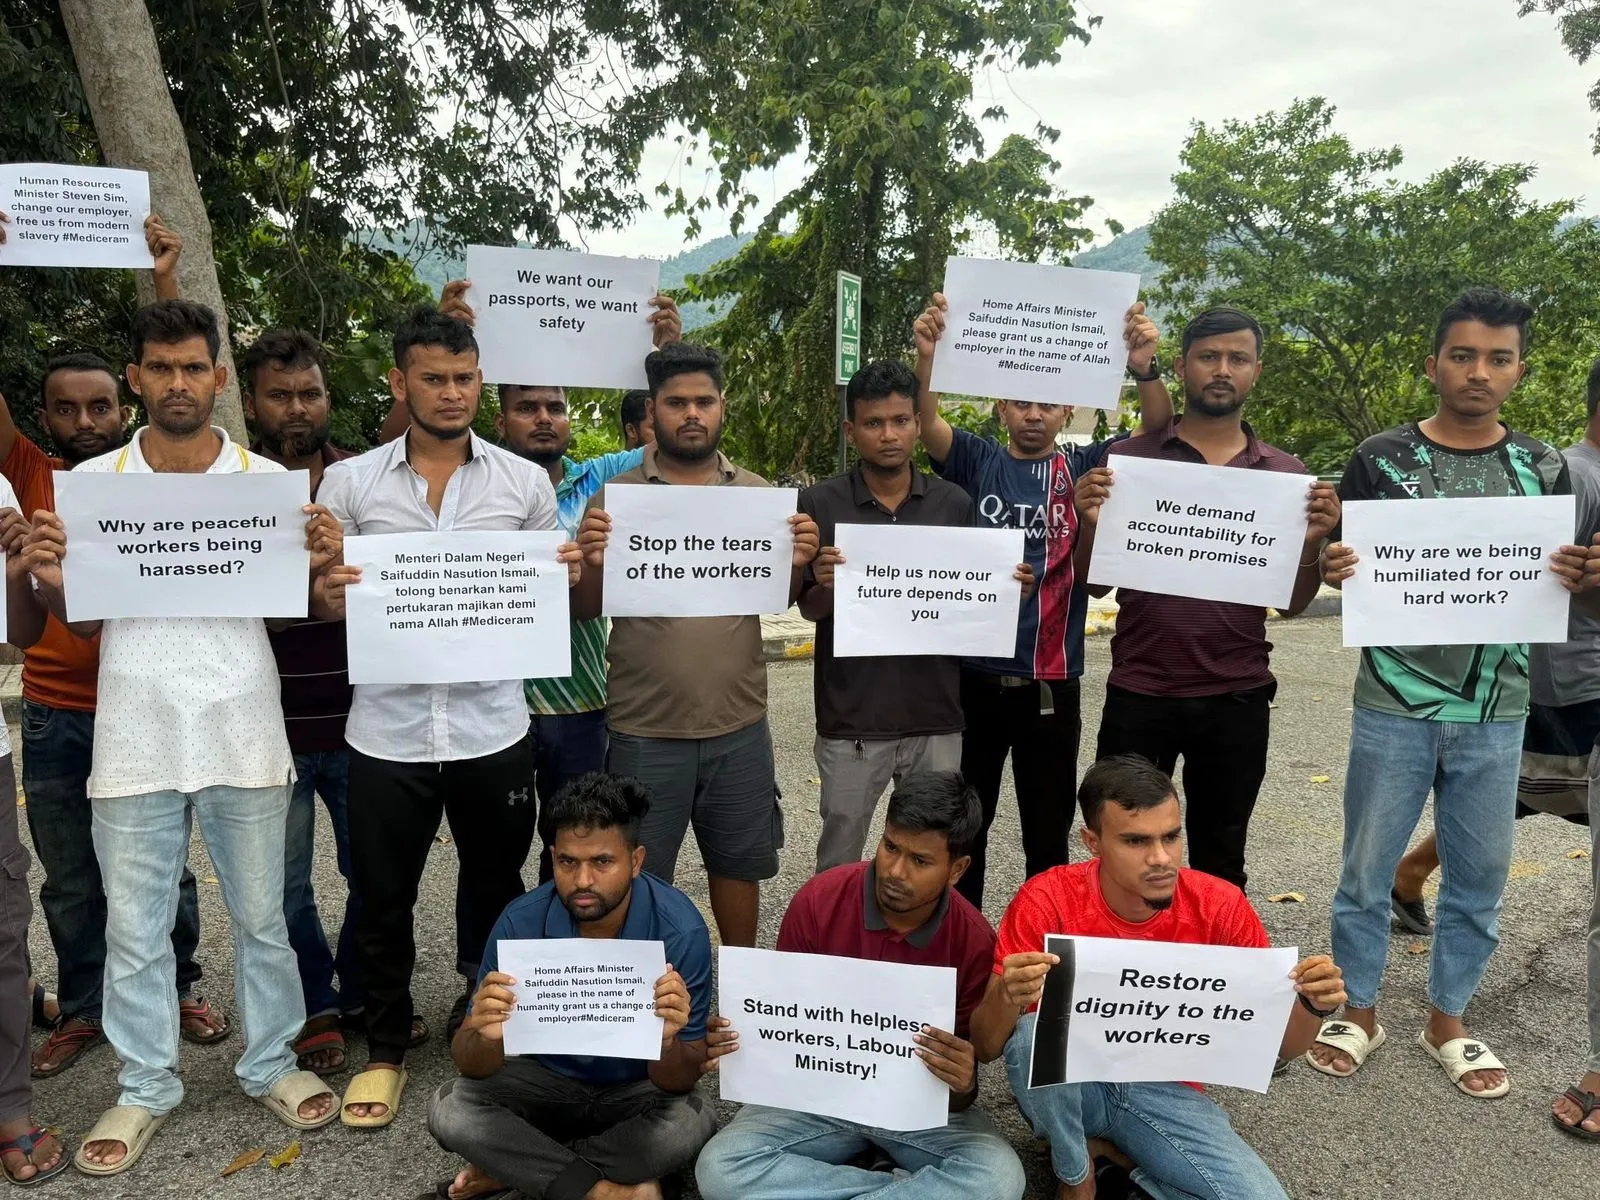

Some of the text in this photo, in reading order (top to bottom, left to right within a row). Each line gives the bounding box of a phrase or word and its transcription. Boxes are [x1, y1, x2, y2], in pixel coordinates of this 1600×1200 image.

[19, 176, 121, 189] Human Resources
[14, 189, 128, 204] Minister Steven Sim,
[11, 202, 132, 218] change our employer,
[16, 216, 38, 226] free
[58, 218, 85, 228] from
[88, 221, 130, 231] modern
[18, 230, 129, 244] slavery #Mediceram
[517, 269, 613, 289] We want our
[488, 294, 638, 314] passports, we want
[982, 299, 1097, 318] Home Affairs Minister
[539, 315, 586, 333] safety
[968, 312, 1106, 336] Saifuddin Nasution Ismail,
[962, 327, 997, 339] please
[999, 332, 1028, 342] grant
[1030, 335, 1043, 344] us
[1054, 336, 1094, 350] change
[1096, 340, 1109, 350] of
[954, 342, 1111, 365] employer in the name of Allah
[998, 359, 1061, 374] #Mediceram
[1156, 499, 1256, 523] We demand
[98, 516, 276, 536] Why are peaceful
[1001, 523, 1070, 539] AWAYS
[1127, 520, 1276, 547] accountability for
[117, 537, 262, 554] workers being
[628, 534, 772, 556] Stop the tears
[1126, 538, 1268, 568] broken promises
[1374, 543, 1542, 563] Why are we being
[394, 551, 525, 565] Menteri Dalam Negeri
[139, 560, 245, 577] harassed?
[380, 567, 540, 581] Saifuddin Nasution Ismail,
[626, 562, 772, 580] of the workers
[866, 564, 992, 582] Help us now our
[1374, 567, 1542, 583] humiliated for our
[395, 583, 527, 599] tolong benarkan kami
[857, 584, 997, 603] future depends on
[1404, 590, 1509, 605] hard work?
[386, 598, 536, 616] pertukaran majikan demi
[911, 609, 939, 622] you
[390, 615, 534, 630] nama Allah #Mediceram
[534, 964, 634, 975] Home Affairs Minister
[524, 976, 645, 988] Saifuddin Nasution Ismail,
[1119, 968, 1227, 992] Restore
[537, 991, 567, 1001] please
[569, 990, 578, 998] in
[580, 989, 596, 998] the
[625, 988, 635, 997] of
[516, 1002, 560, 1012] humanity
[562, 1002, 587, 1012] grant
[602, 1002, 608, 1010] a
[610, 1001, 644, 1012] change
[743, 998, 798, 1019] Stand
[804, 1005, 844, 1023] with
[1074, 997, 1255, 1022] dignity to the
[538, 1013, 635, 1024] employer#Mediceram
[758, 1028, 915, 1058] workers, Labour
[1104, 1027, 1211, 1046] workers
[795, 1053, 877, 1081] Ministry!
